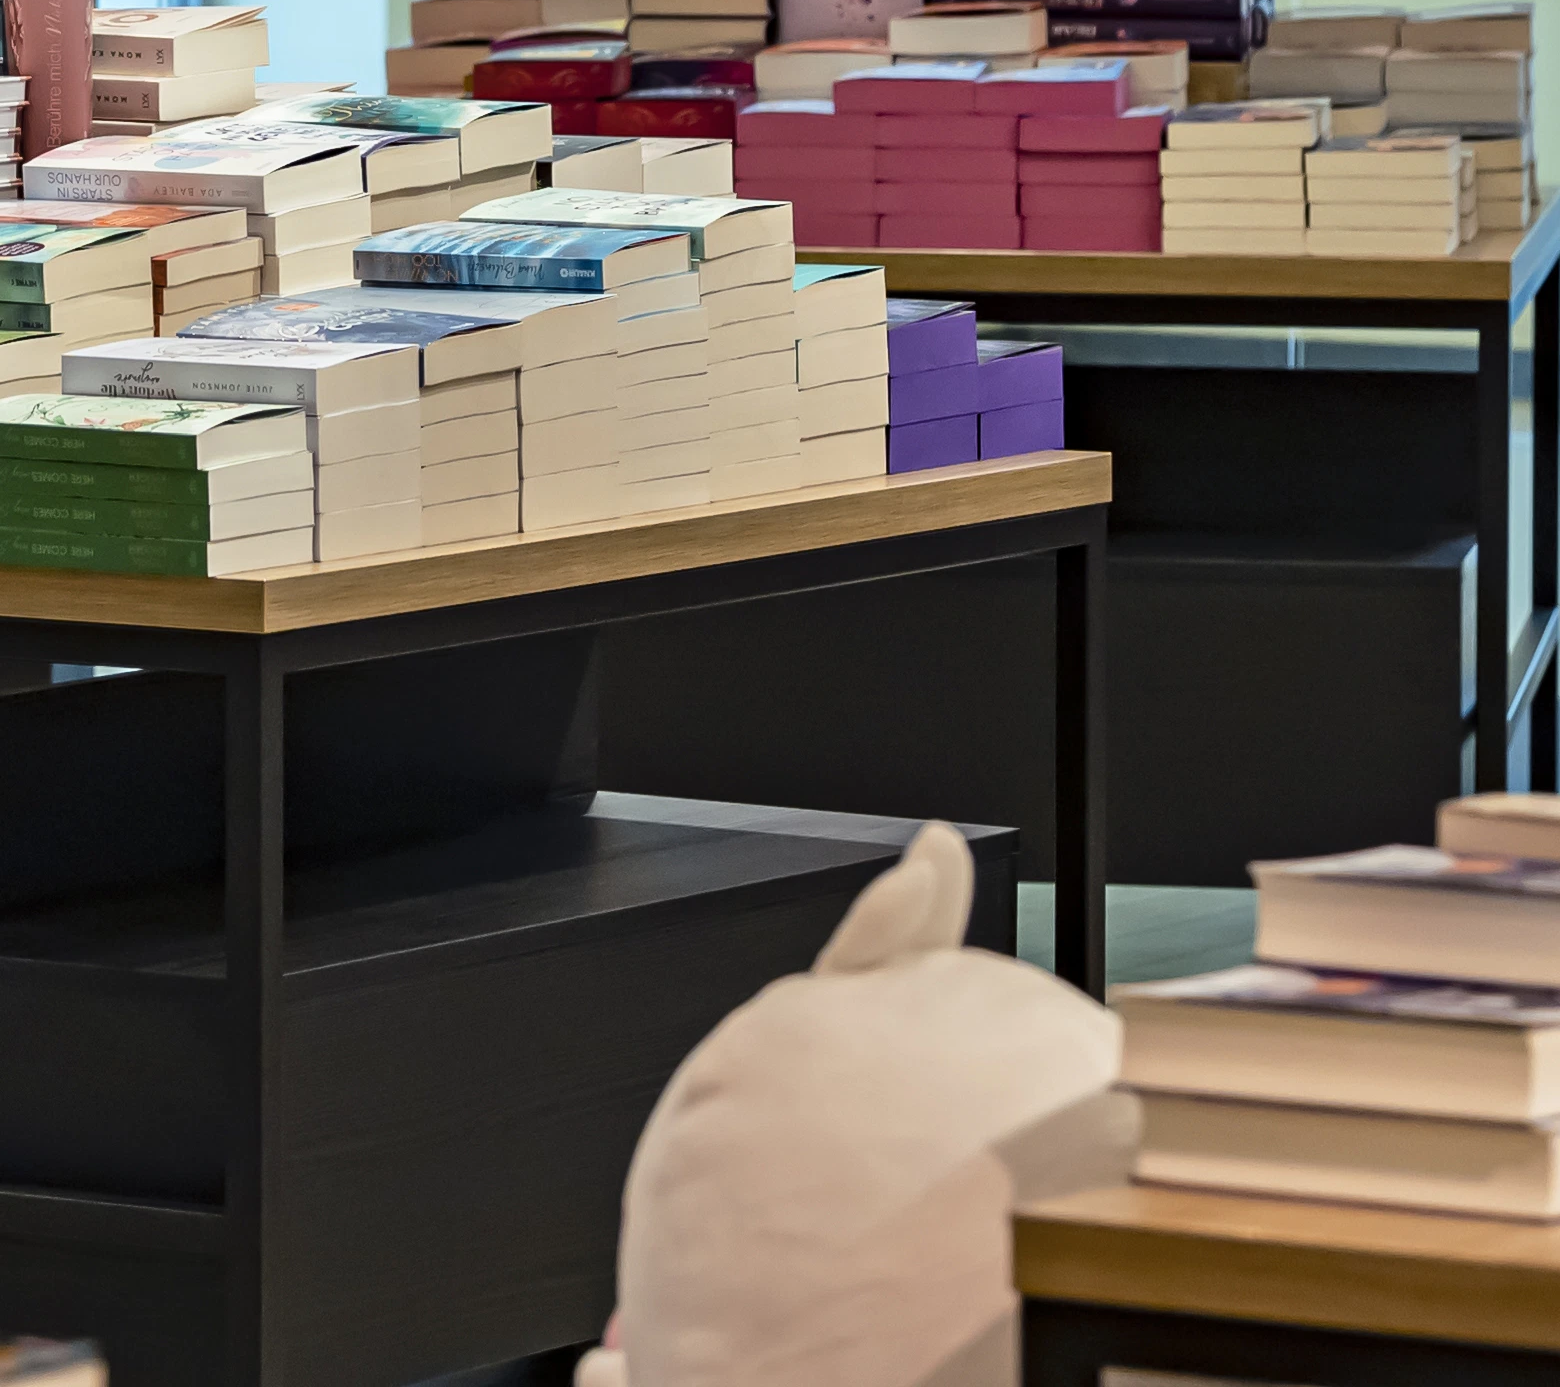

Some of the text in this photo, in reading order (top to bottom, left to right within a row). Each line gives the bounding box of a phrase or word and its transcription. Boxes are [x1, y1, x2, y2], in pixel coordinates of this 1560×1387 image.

[156, 48, 165, 65] LYX
[47, 88, 63, 148] Berühre
[47, 171, 122, 186] OUR HANDS
[57, 187, 114, 200] STARS IN
[152, 186, 222, 197] ADA BAILEY
[192, 382, 274, 394] JULIE JOHNSON
[296, 383, 305, 401] LYX
